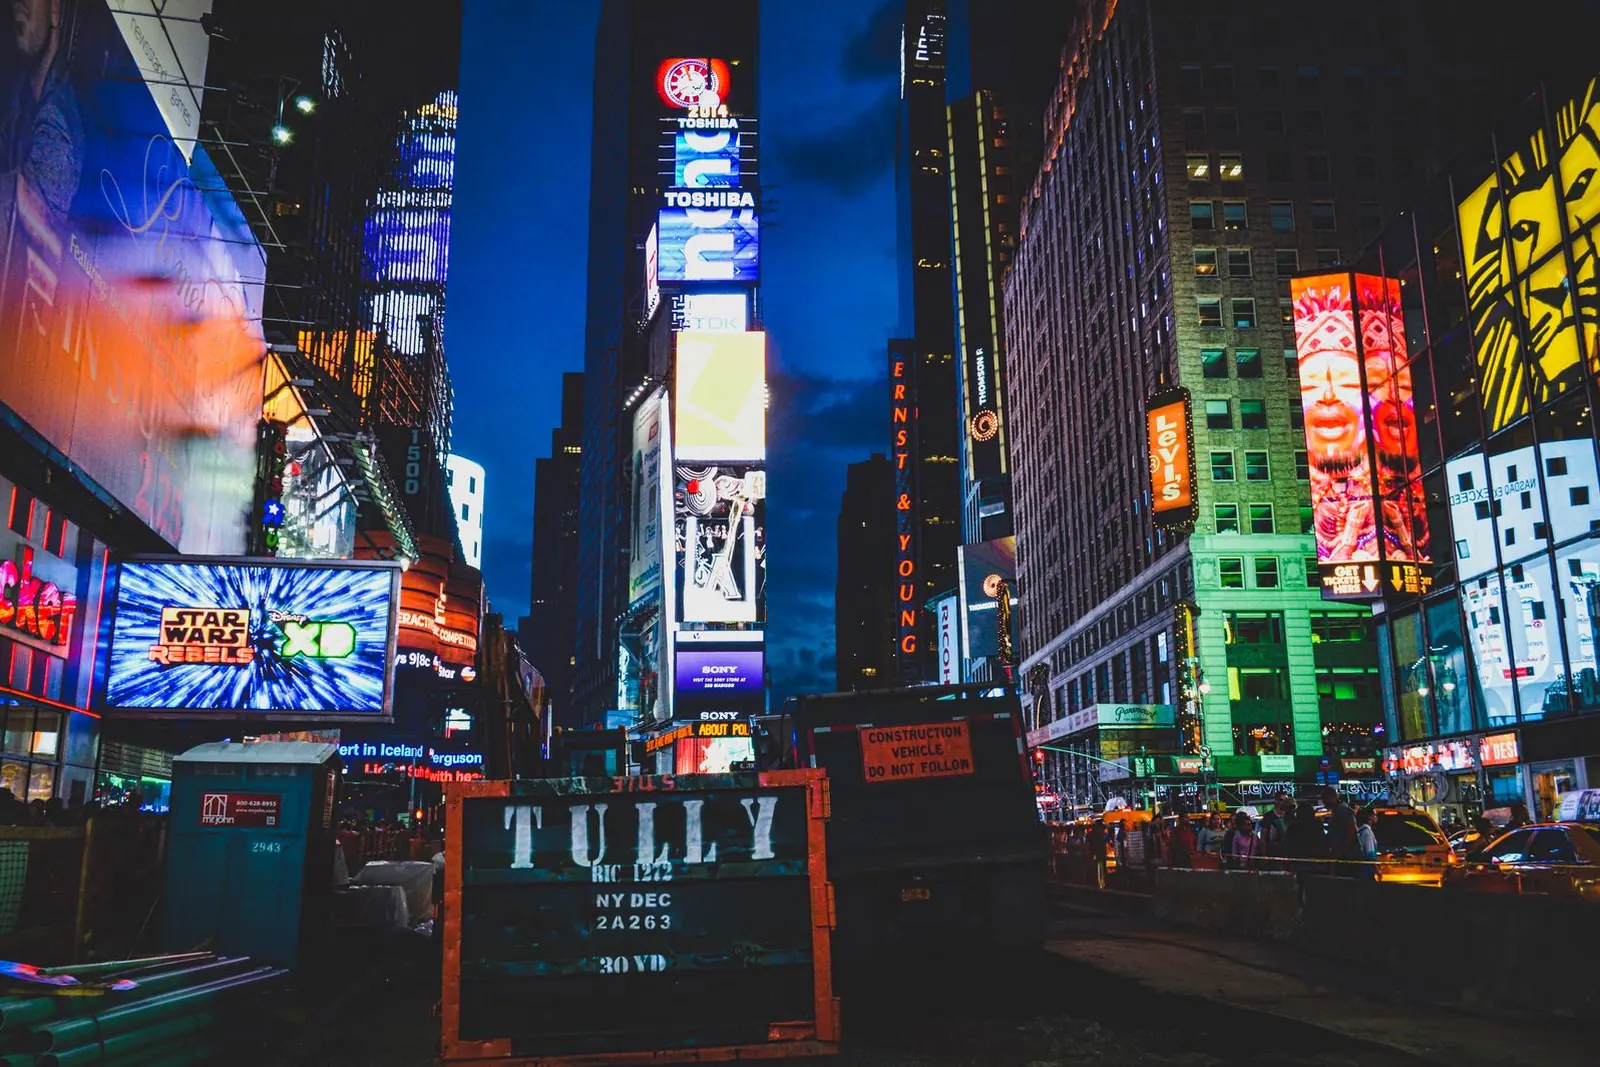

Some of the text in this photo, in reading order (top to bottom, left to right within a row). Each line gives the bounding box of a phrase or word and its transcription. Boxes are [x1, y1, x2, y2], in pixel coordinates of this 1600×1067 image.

[677, 118, 739, 129] TOSHIBA
[664, 192, 756, 208] TOSHIBA
[691, 316, 739, 331] TDK
[975, 355, 987, 406] THOMSON
[404, 429, 421, 495] 1500
[893, 361, 918, 656] ERNST & YOUNG
[1333, 564, 1361, 577] GET
[1322, 575, 1362, 587] TICKETS
[164, 610, 246, 628] STAR
[164, 627, 246, 645] WARS
[281, 621, 357, 659] XD
[149, 645, 255, 664] REBELS
[941, 605, 951, 688] RICOH
[702, 665, 738, 674] SONY
[700, 712, 739, 720] SONY
[1115, 706, 1158, 723] Paramount
[698, 724, 728, 736] ABOUT
[868, 726, 963, 744] CONSTRUCTION
[363, 743, 377, 757] in
[380, 743, 424, 759] Iceland
[891, 743, 944, 759] VEHICLE
[430, 767, 457, 782] with
[869, 758, 970, 778] DO NOT FOLLOW
[504, 796, 779, 869] TULLY
[251, 842, 281, 853] 2943
[592, 863, 622, 883] RIC
[596, 893, 672, 908] NY DEC
[596, 915, 673, 931] 2A263
[599, 953, 668, 975] 30 YD
